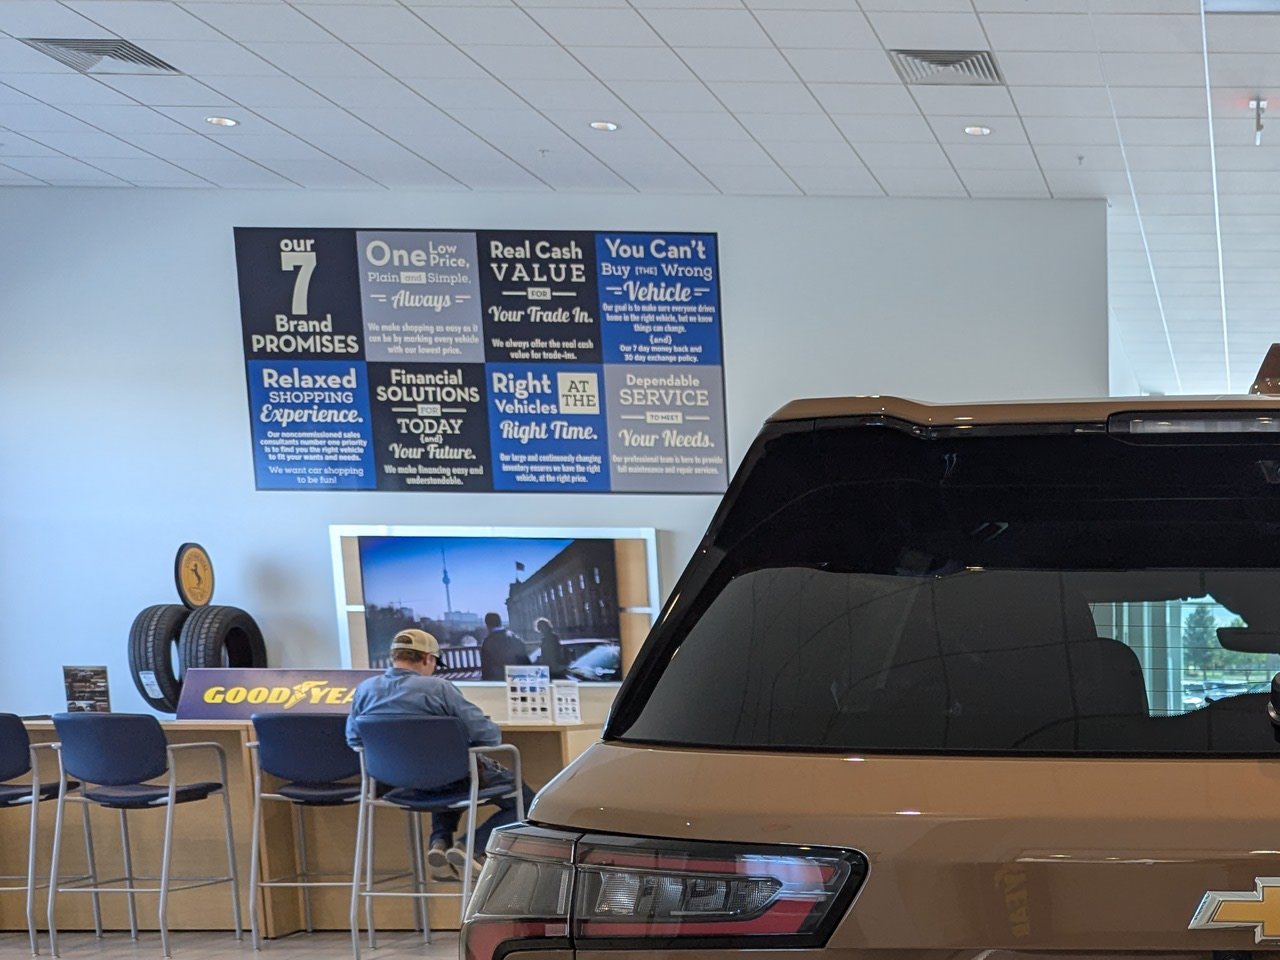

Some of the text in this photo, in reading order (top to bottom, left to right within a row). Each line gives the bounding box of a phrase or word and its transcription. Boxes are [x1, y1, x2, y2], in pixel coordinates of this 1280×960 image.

[280, 239, 314, 251] our
[366, 240, 427, 266] One
[429, 241, 457, 254] Low
[490, 240, 582, 259] Real Cash
[605, 238, 706, 259] You Can't
[430, 255, 470, 268] Price,
[368, 272, 398, 282] Plain
[490, 263, 586, 282] VALUE
[601, 263, 630, 279] Buy
[661, 263, 712, 281] Wrong
[281, 252, 316, 315] 7
[623, 281, 692, 301] Vehicle
[391, 290, 451, 312] Always
[488, 306, 594, 323] Your Trade In.
[275, 314, 332, 332] Brand
[402, 323, 434, 334] shopping
[252, 334, 359, 353] PROMISES
[455, 335, 479, 343] vehicle
[492, 338, 594, 349] We always offer the real cash
[388, 346, 403, 354] with
[510, 350, 530, 359] value
[531, 350, 541, 359] for
[638, 345, 649, 353] day
[634, 354, 645, 362] day
[262, 368, 357, 388] Relaxed
[391, 368, 462, 385] Financial
[626, 374, 700, 388] Dependable
[492, 372, 552, 399] Right
[568, 380, 589, 393] AT
[269, 391, 353, 404] SHOPPING
[376, 386, 480, 402] SOLUTIONS
[562, 394, 596, 407] THE
[620, 388, 709, 406] SERVICE
[494, 399, 557, 414] Vehicles
[260, 404, 363, 427] Experience.
[397, 418, 463, 434] TODAY
[500, 419, 598, 444] Right Time.
[342, 439, 367, 447] priority
[619, 429, 715, 448] Your Needs.
[389, 443, 476, 459] Your Future.
[324, 467, 364, 476] shopping
[384, 464, 484, 476] We make financing easy and
[204, 681, 356, 704] GOODYEA
